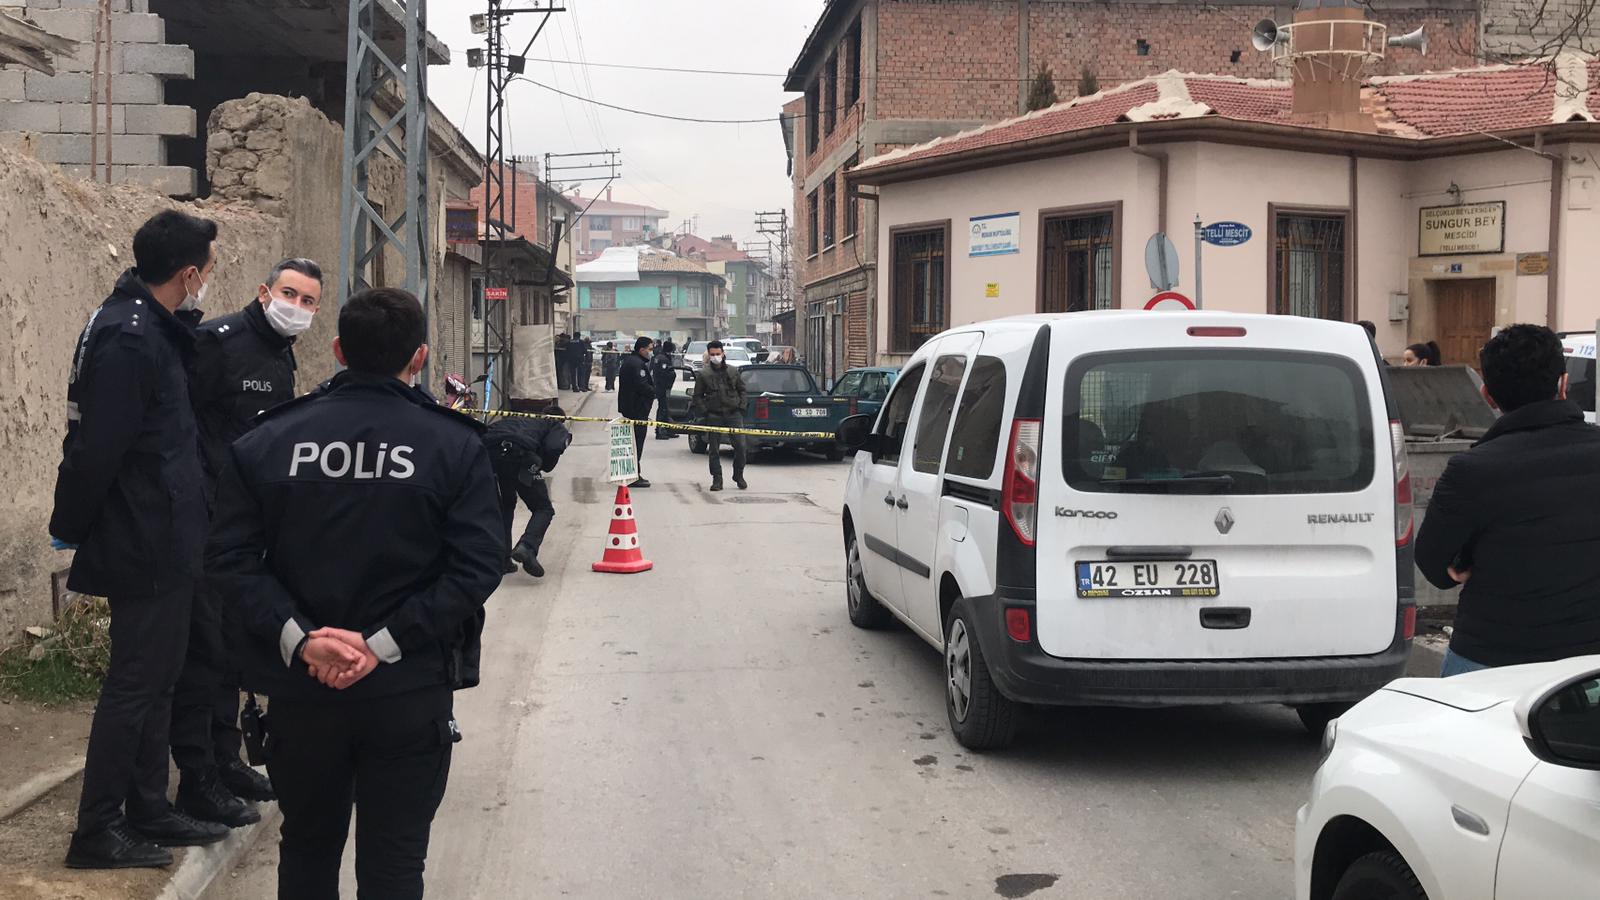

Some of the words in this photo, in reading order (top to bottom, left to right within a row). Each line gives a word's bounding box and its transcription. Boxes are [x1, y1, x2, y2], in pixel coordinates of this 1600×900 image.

[1425, 218, 1471, 230] SUNGUR
[1474, 216, 1497, 227] BEY
[1225, 226, 1249, 238] MESCİT
[1579, 345, 1595, 355] 112
[1307, 512, 1375, 524] RENAULT
[1093, 565, 1118, 587] 42
[1133, 564, 1159, 586] EU
[1174, 563, 1213, 586] 228
